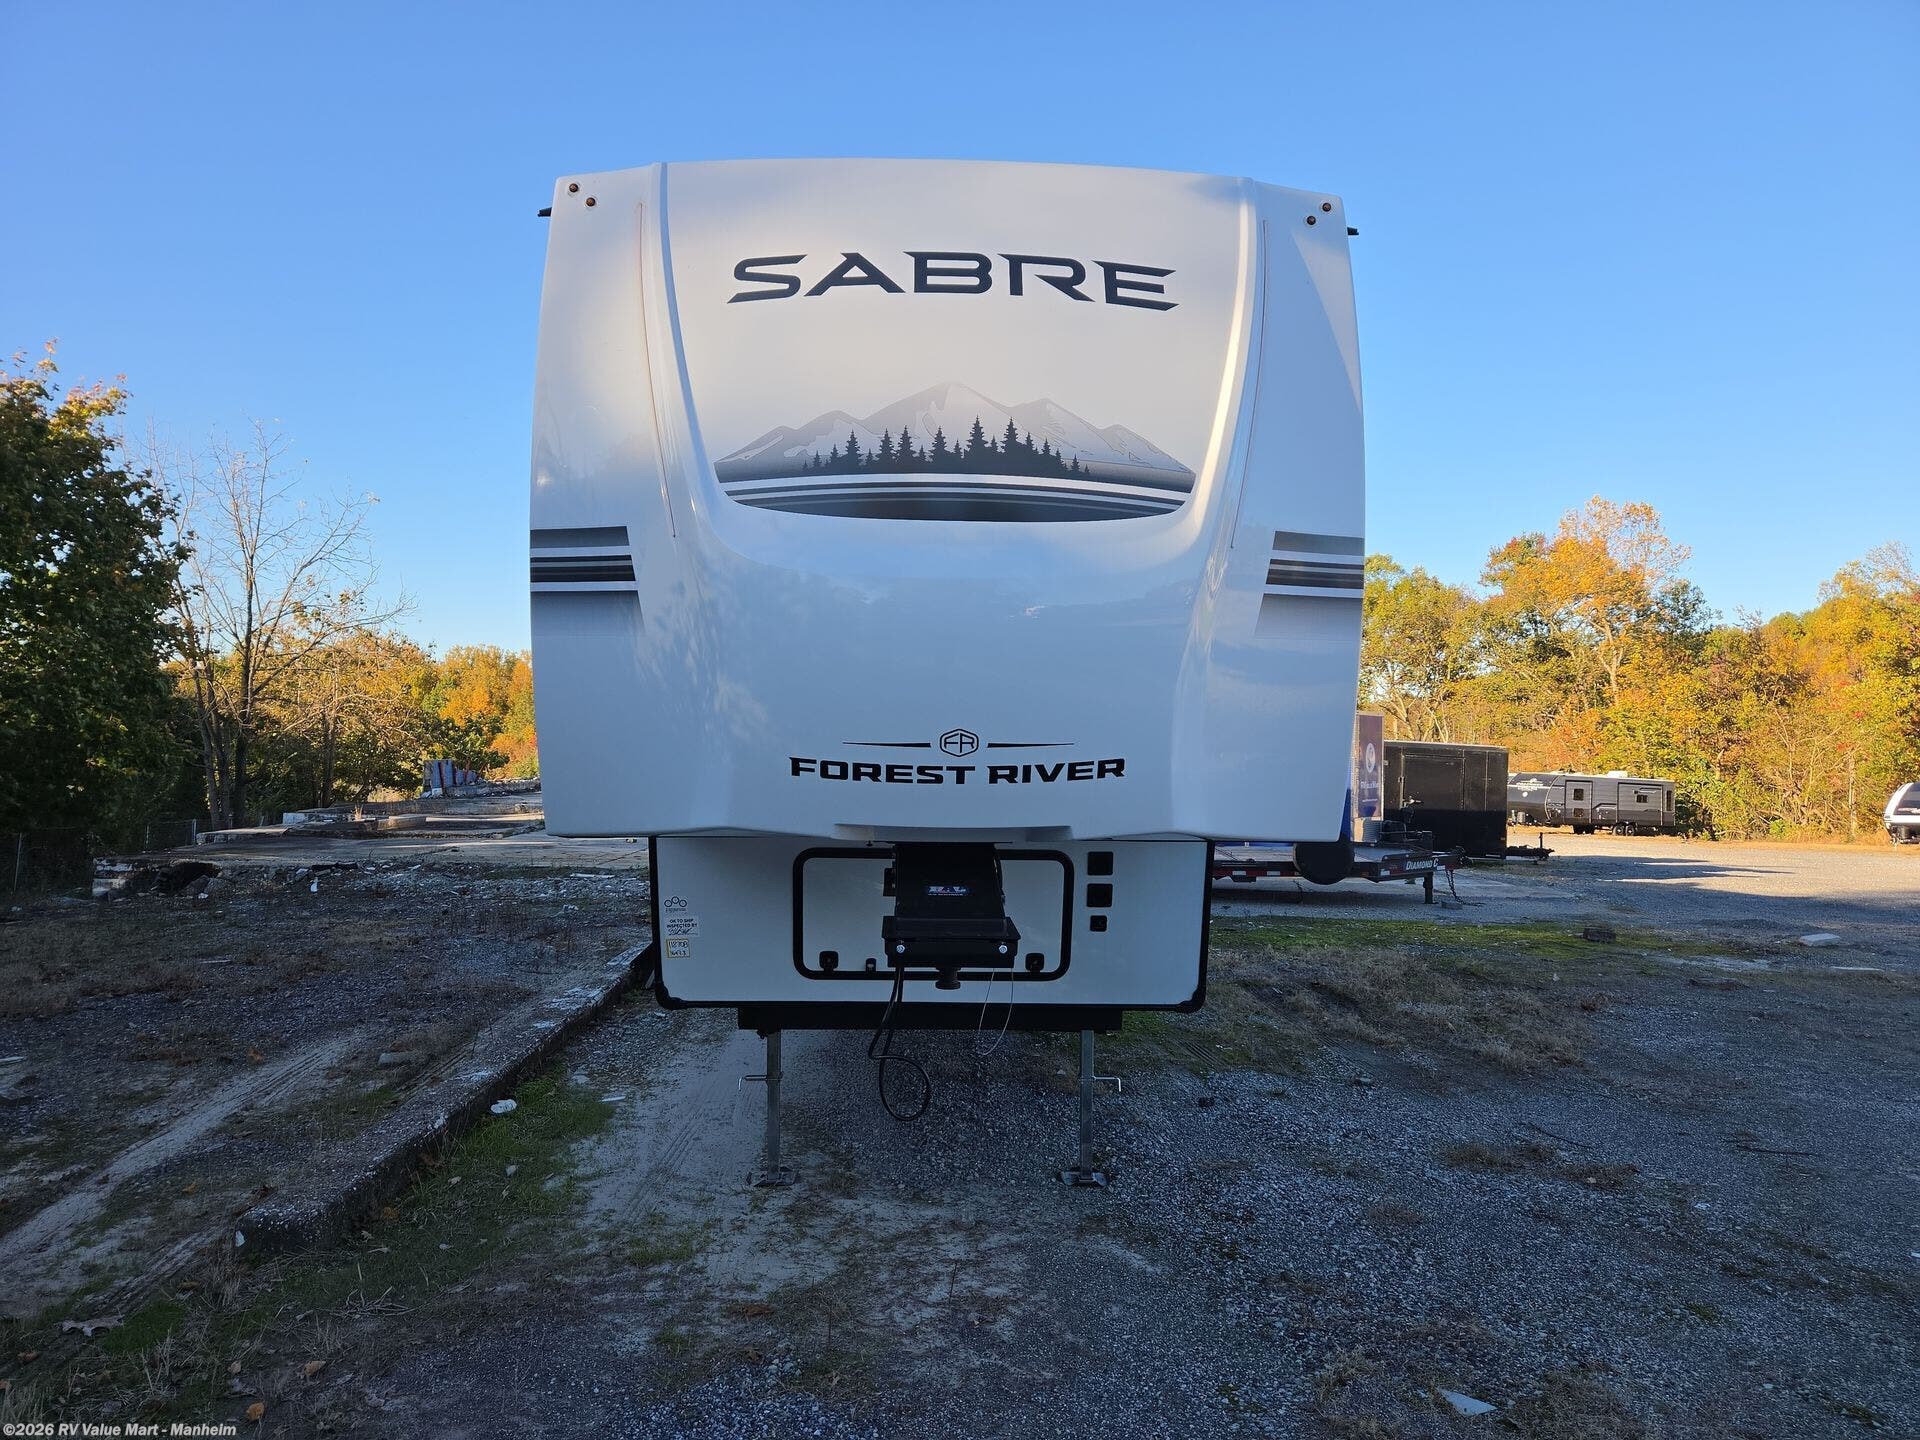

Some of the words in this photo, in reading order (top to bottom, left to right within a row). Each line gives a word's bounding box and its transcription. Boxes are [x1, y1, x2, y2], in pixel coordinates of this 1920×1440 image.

[727, 251, 1180, 311] SABRE
[789, 757, 975, 784] FOREST
[987, 758, 1125, 784] RIVER
[1405, 860, 1433, 871] DIAMOND
